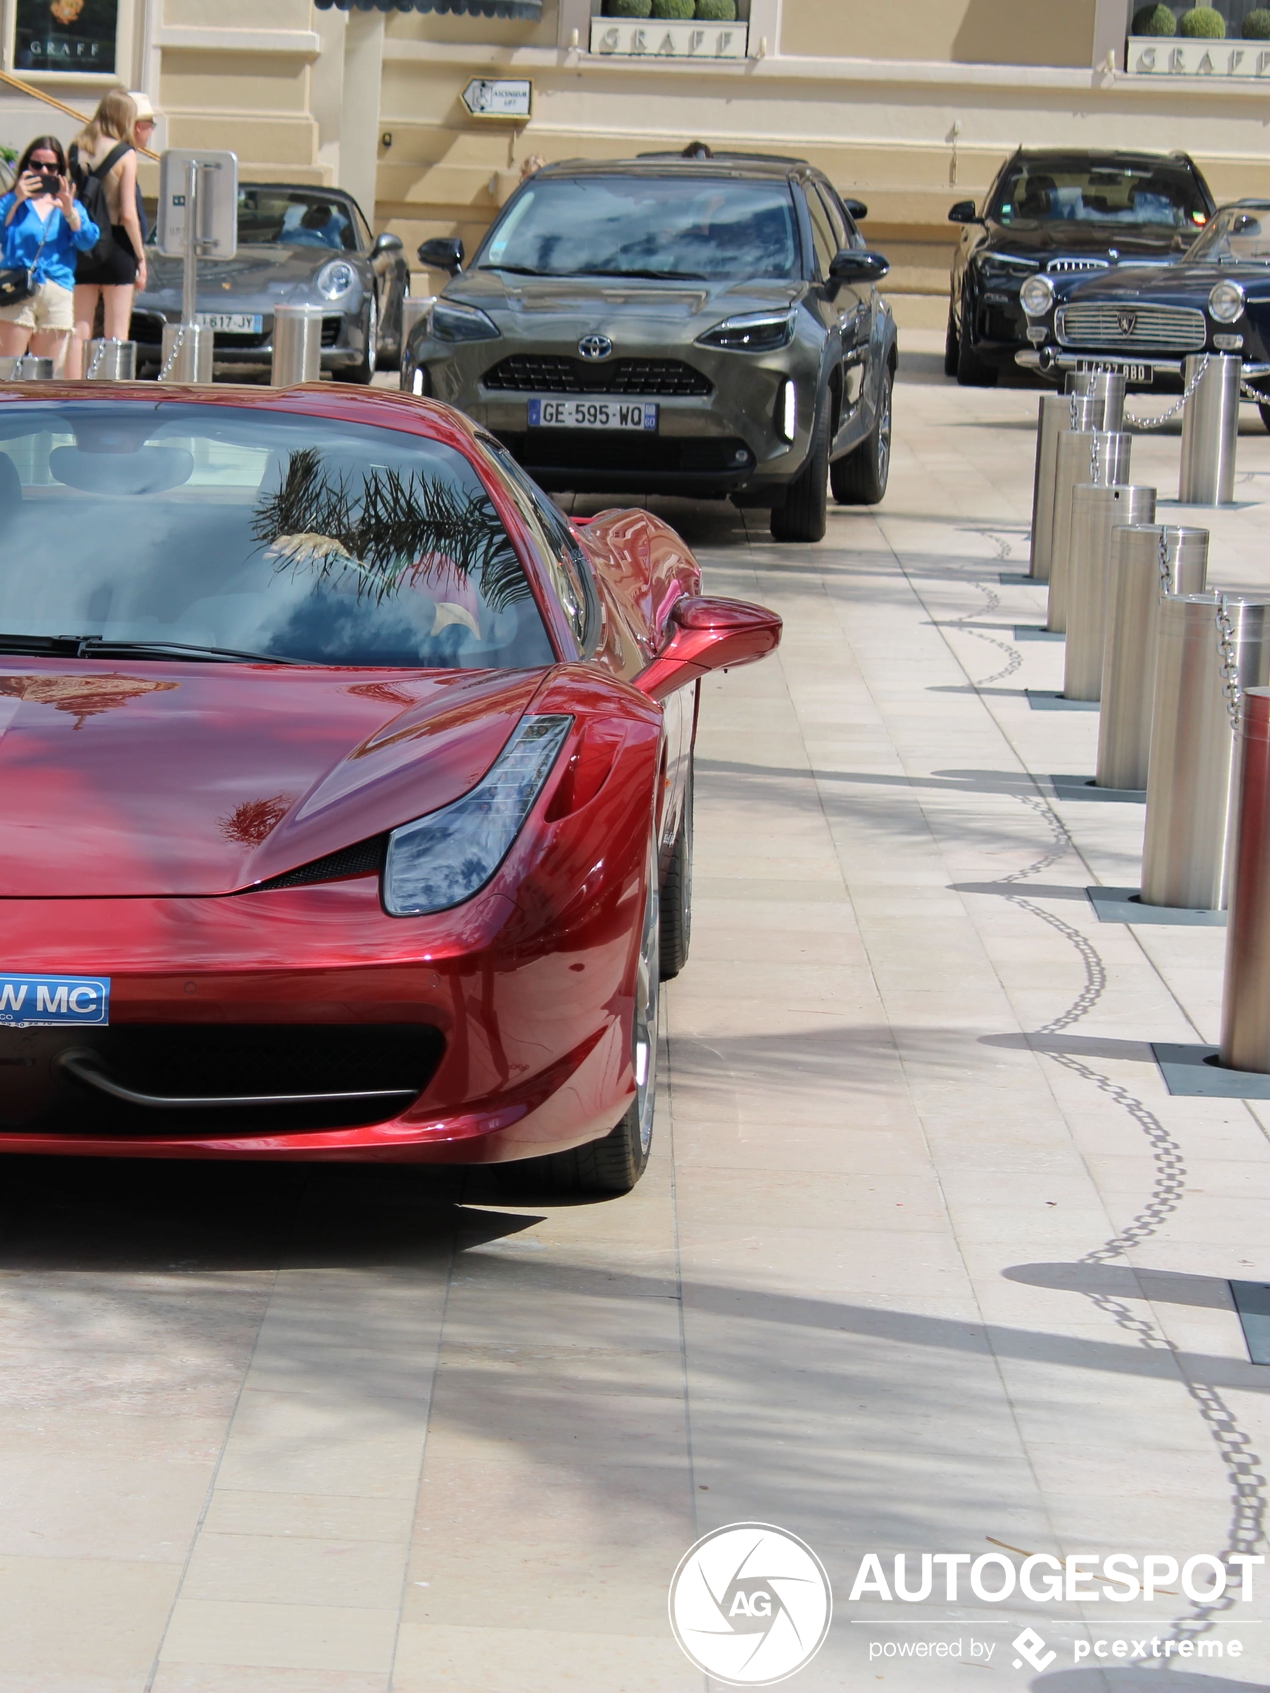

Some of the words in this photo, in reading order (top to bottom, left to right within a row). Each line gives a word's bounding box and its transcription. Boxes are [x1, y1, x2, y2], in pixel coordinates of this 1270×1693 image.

[30, 41, 99, 56] GRAFF
[605, 27, 732, 50] GRAFF
[36, 985, 97, 1013] MC
